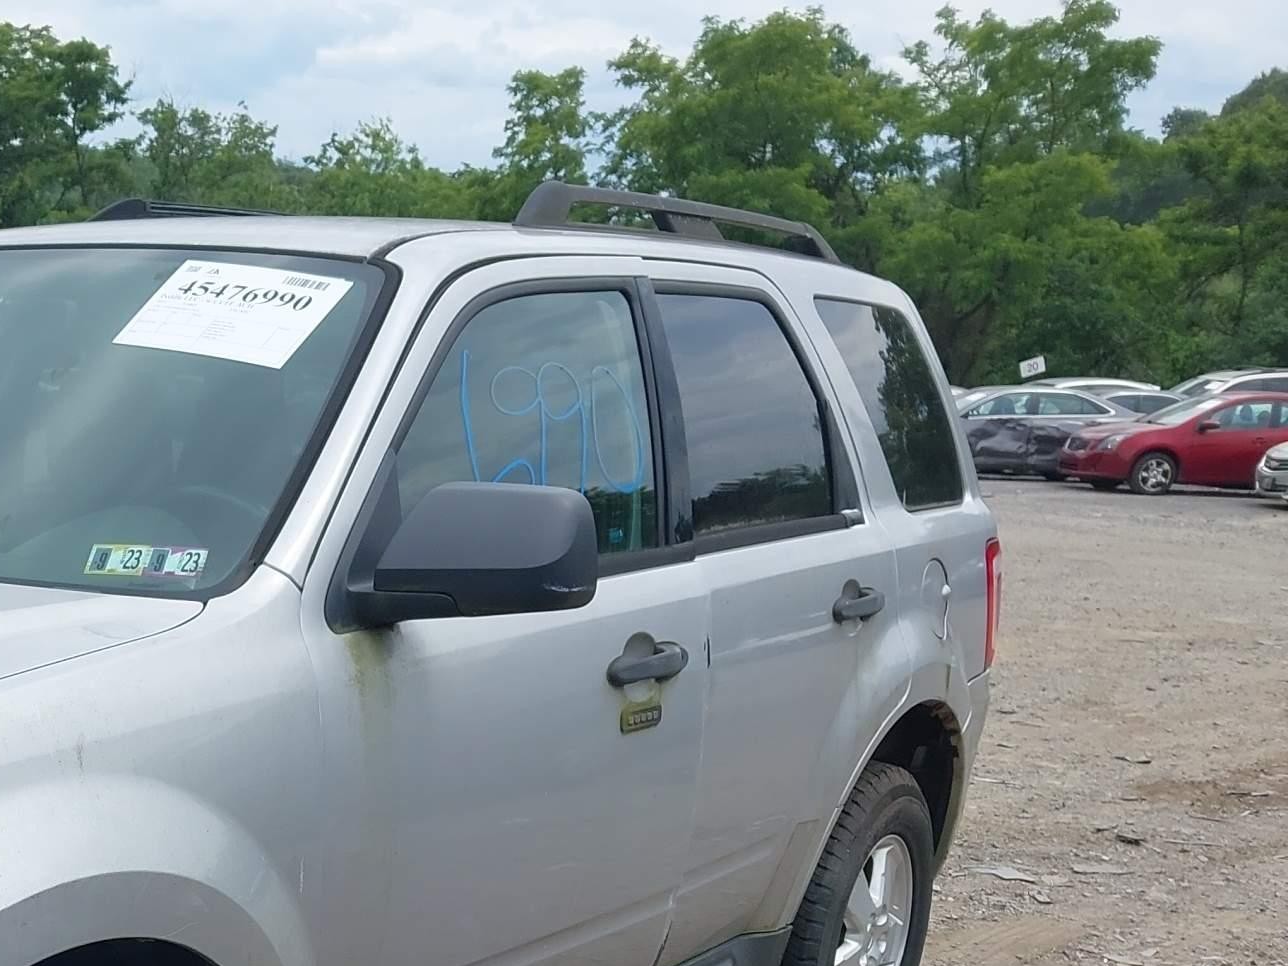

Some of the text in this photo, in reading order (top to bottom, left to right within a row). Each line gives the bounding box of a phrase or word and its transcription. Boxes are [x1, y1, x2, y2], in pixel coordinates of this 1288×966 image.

[178, 280, 314, 312] 45476990
[122, 549, 143, 570] 23
[181, 552, 201, 573] 23
